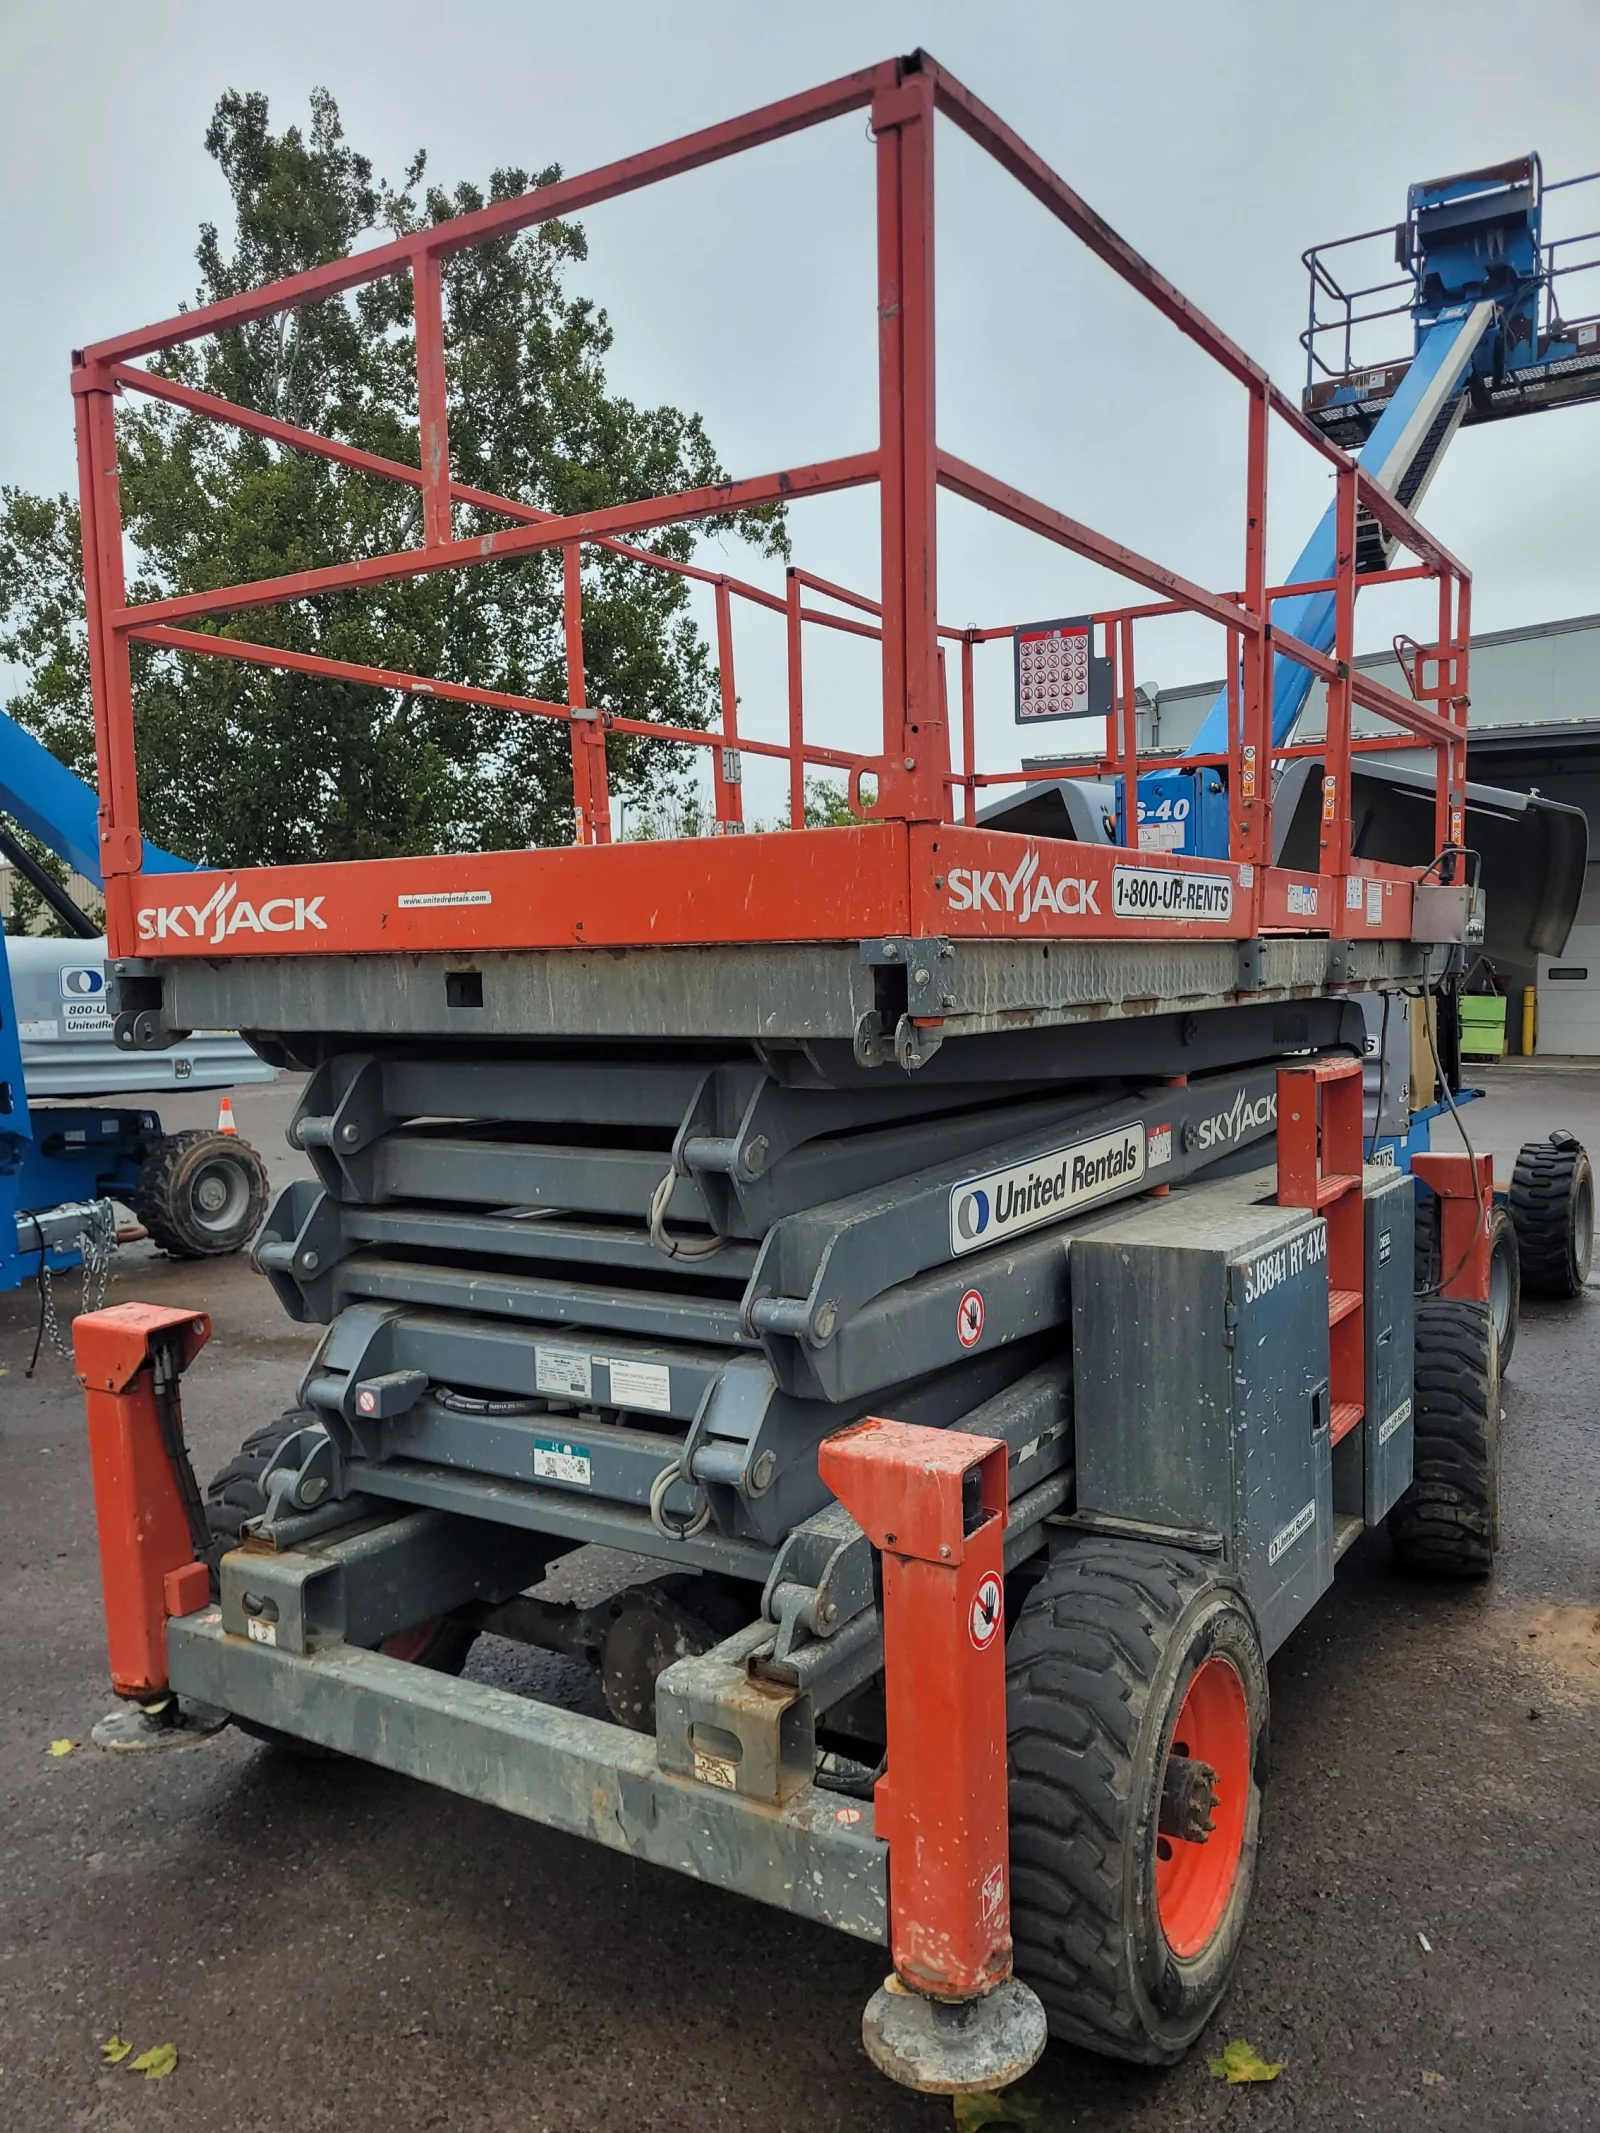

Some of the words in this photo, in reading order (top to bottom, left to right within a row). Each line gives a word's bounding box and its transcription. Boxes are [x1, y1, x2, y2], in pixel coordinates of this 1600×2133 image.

[137, 881, 328, 944] SKYJACK
[403, 894, 487, 906] www.unitedrentals.com
[948, 849, 1101, 922] SKYJACK
[1116, 877, 1229, 913] 1-800-UR-RENTS
[67, 1020, 114, 1030] UnitedRe
[69, 1005, 106, 1015] 800-U
[1198, 1087, 1277, 1150] SKYJACK
[996, 1161, 1067, 1224] United
[1071, 1138, 1137, 1194] Rentals
[1245, 1247, 1287, 1304] SJ8841
[1290, 1237, 1304, 1277] RT
[1306, 1225, 1327, 1265] 4X4
